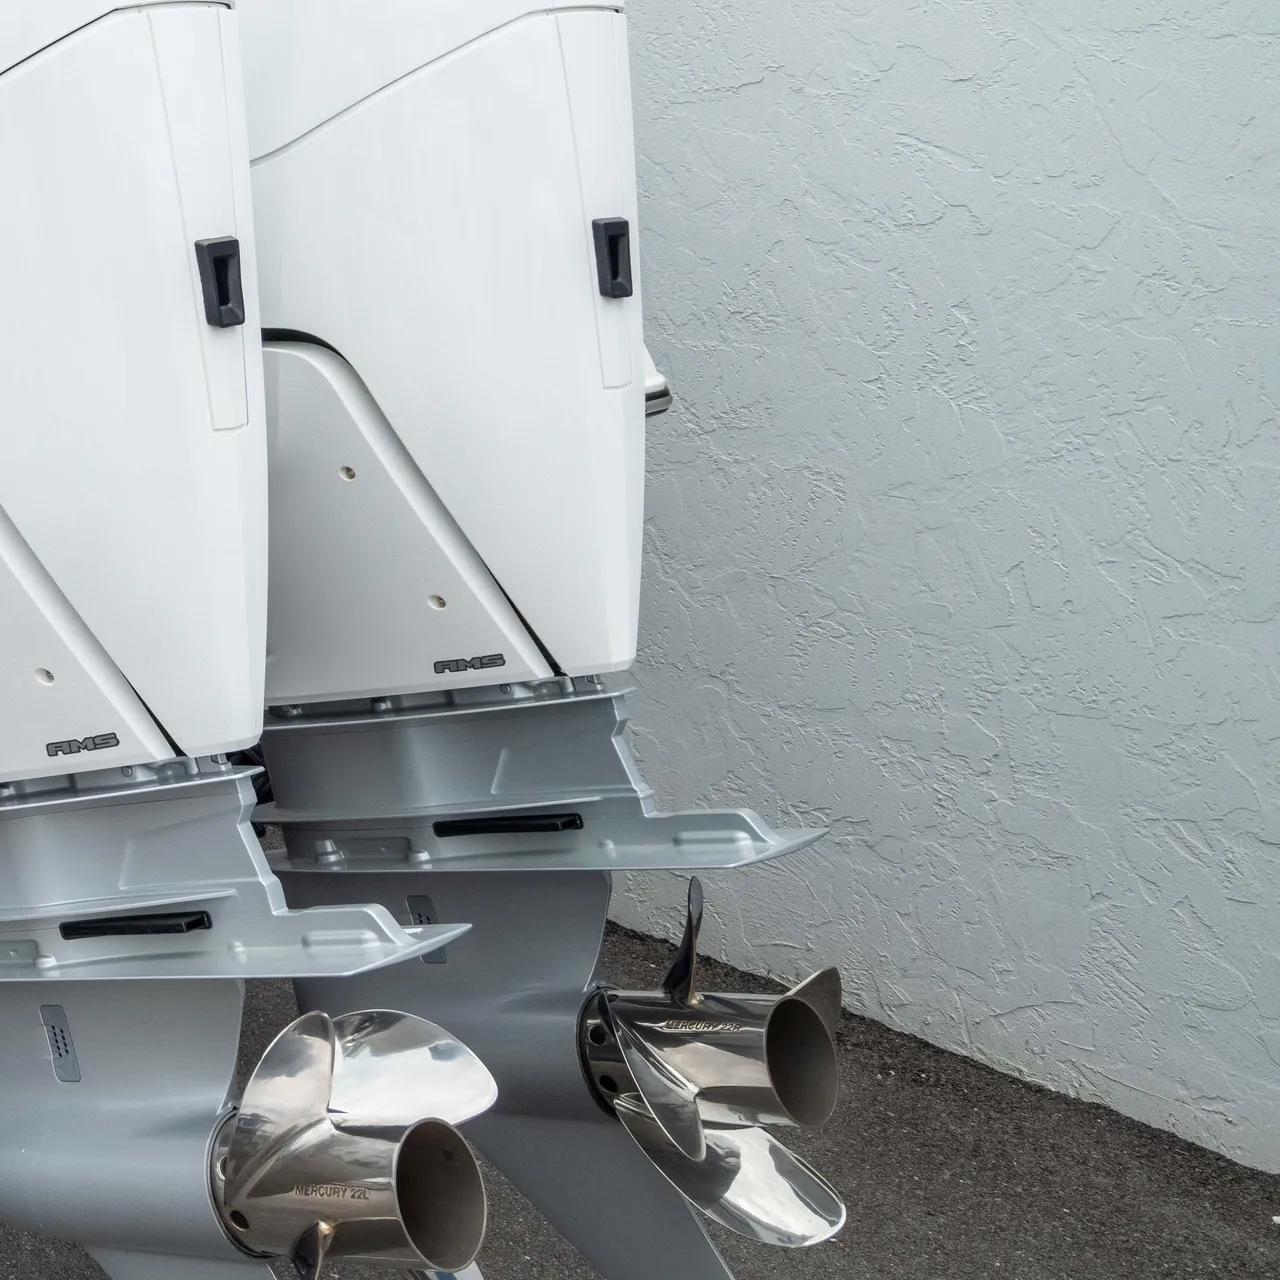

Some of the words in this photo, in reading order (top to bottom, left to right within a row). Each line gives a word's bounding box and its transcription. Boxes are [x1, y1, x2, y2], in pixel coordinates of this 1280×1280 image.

[433, 653, 506, 674] AMS
[46, 732, 120, 757] AMS
[664, 1020, 717, 1030] MERCURY
[294, 1184, 347, 1198] MERCURY
[350, 1187, 370, 1200] 22L
